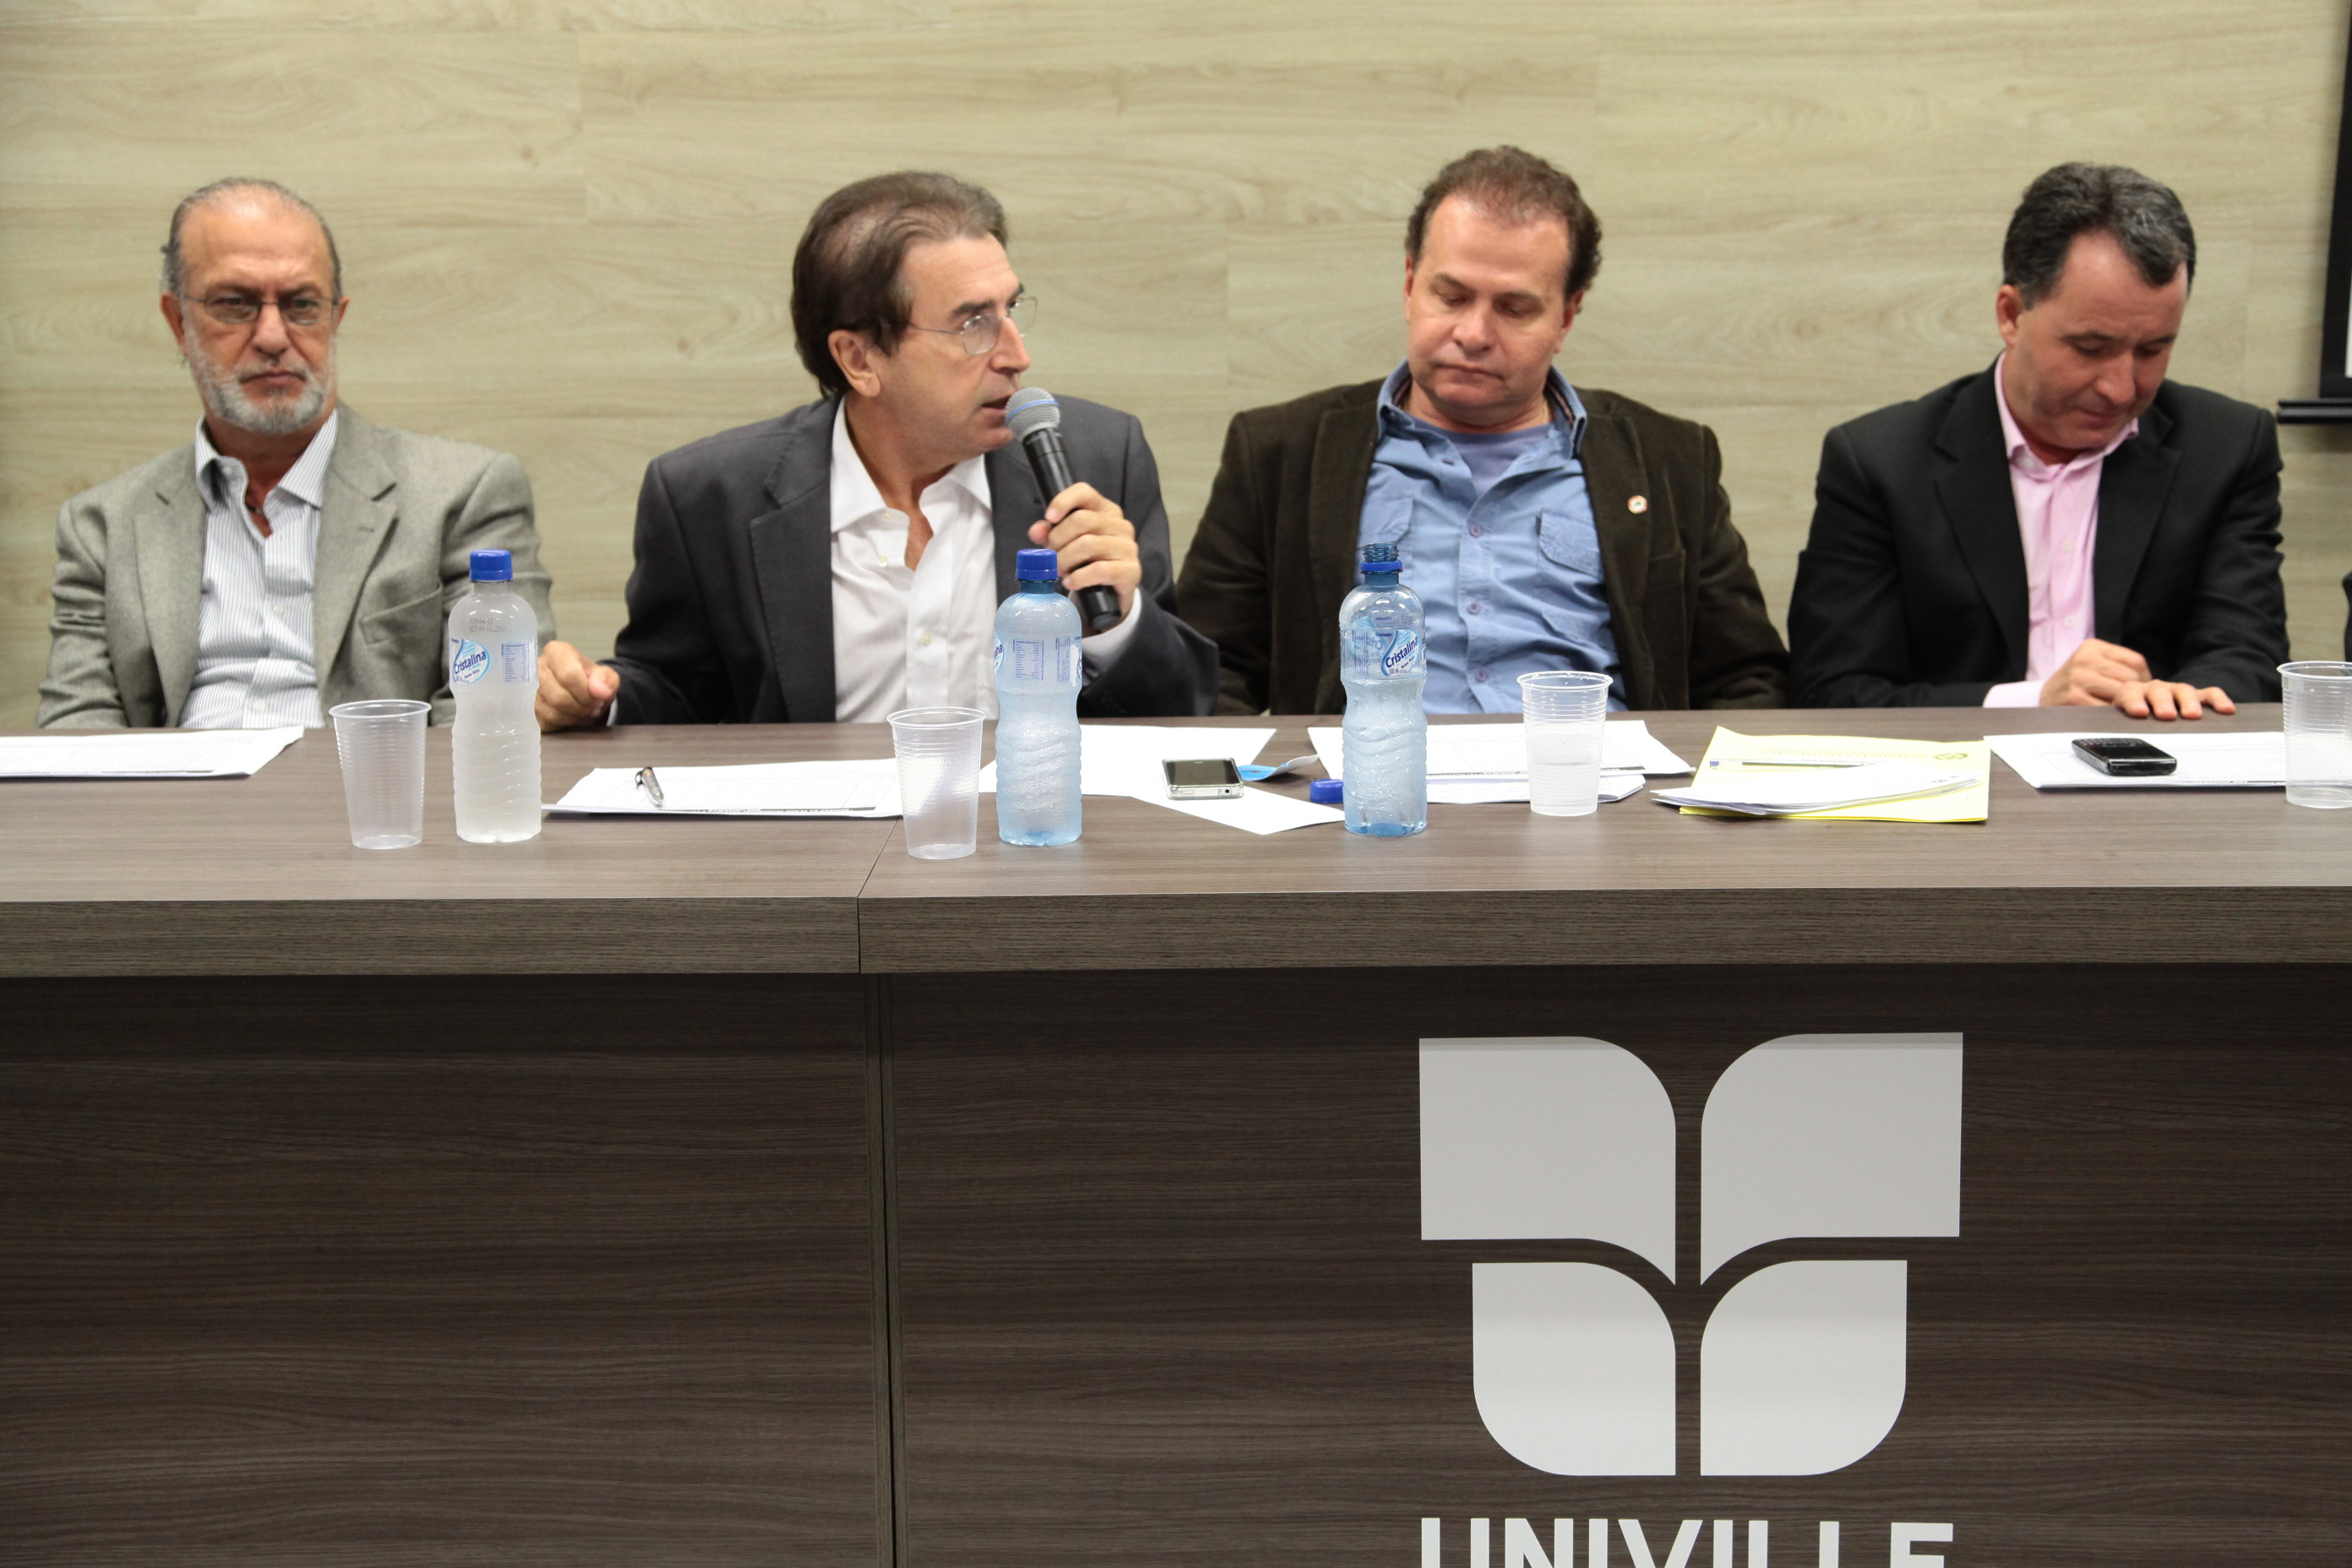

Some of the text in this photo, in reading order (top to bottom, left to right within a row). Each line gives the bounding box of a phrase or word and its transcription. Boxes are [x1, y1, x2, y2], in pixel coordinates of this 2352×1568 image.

[454, 651, 487, 674] Cristalina
[1386, 637, 1418, 668] Cristalina
[1421, 1517, 1954, 1568] UNIVILLE
